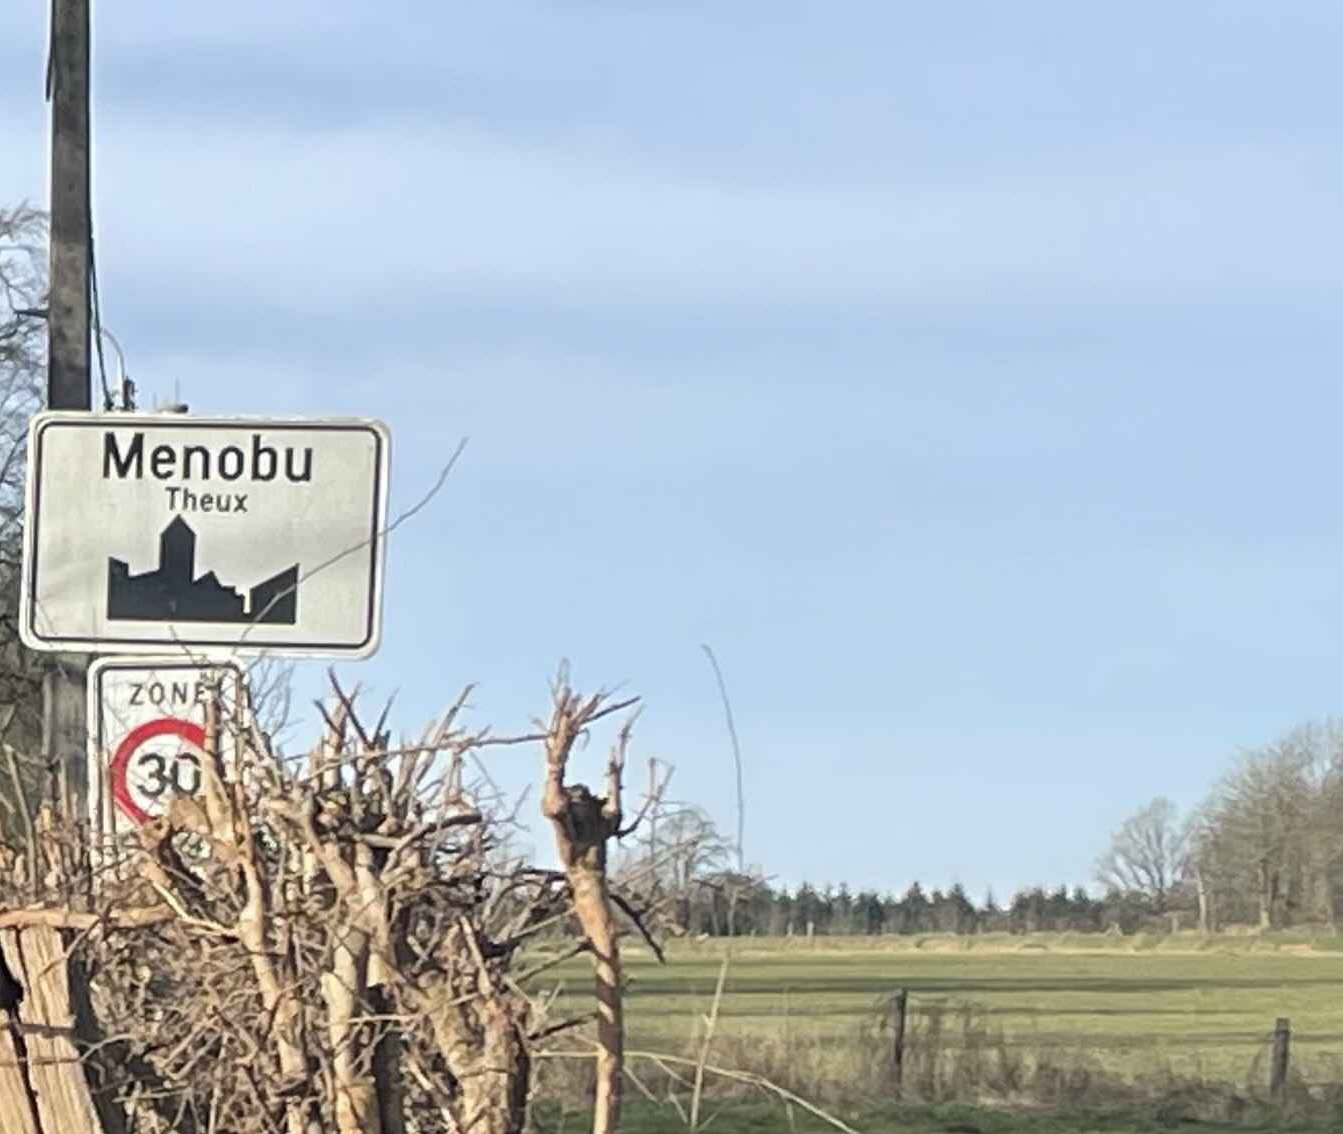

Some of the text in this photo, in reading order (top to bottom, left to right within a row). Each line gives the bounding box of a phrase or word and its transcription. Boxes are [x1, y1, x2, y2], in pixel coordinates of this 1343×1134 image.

[102, 432, 313, 482] Menobu
[165, 487, 248, 513] Theux
[129, 681, 207, 706] ZONE
[137, 753, 201, 798] 30
